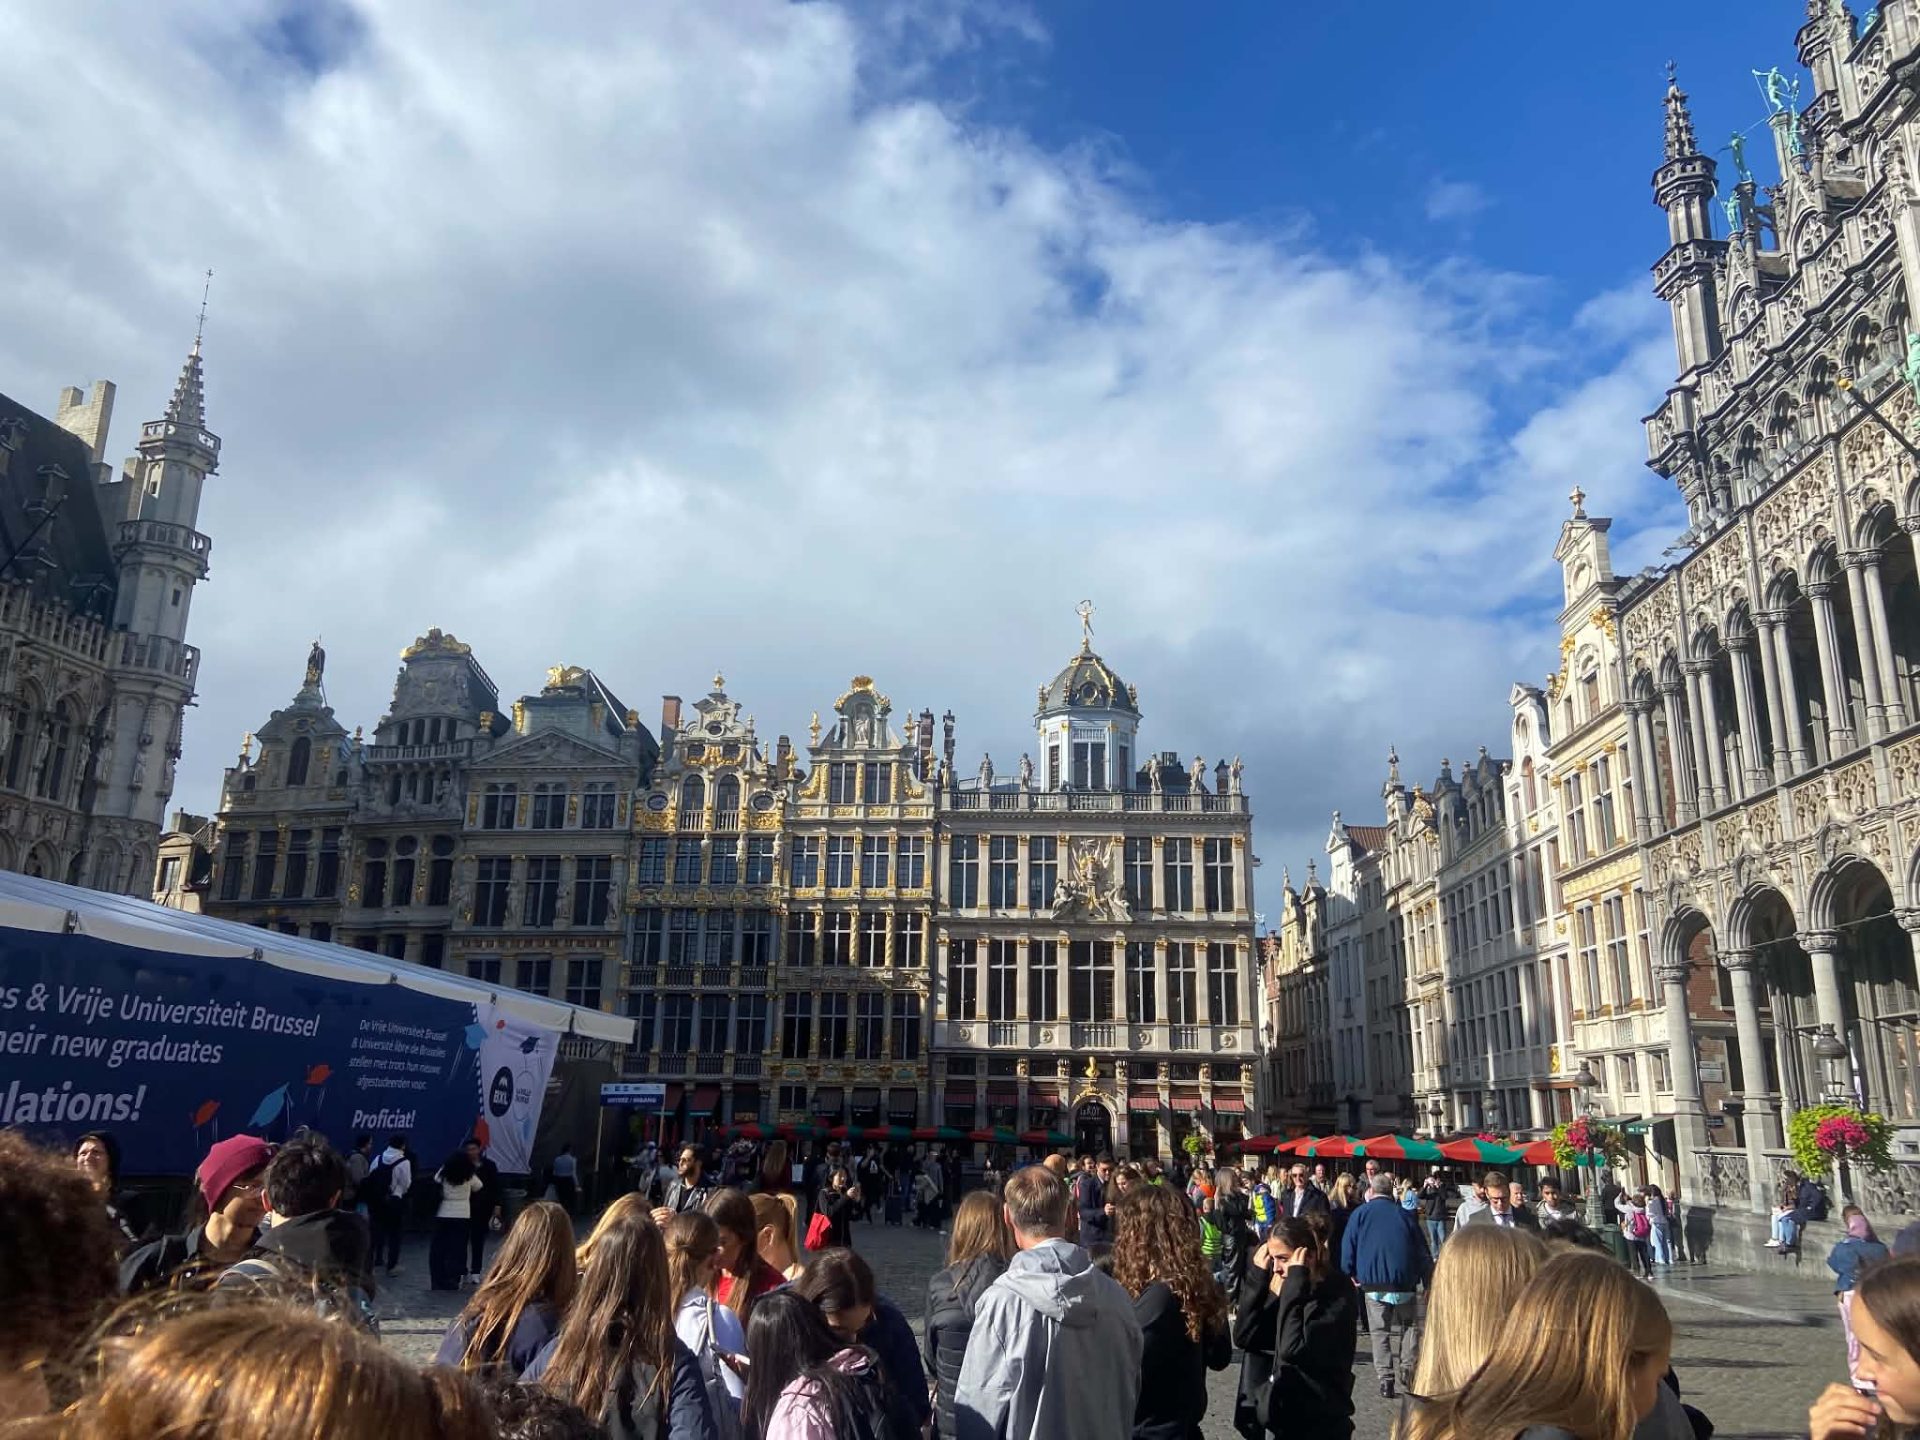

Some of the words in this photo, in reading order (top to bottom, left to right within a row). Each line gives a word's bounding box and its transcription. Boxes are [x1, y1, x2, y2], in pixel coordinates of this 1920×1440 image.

[25, 982, 50, 1012] &
[58, 984, 114, 1026] Vrije
[120, 993, 248, 1029] Universiteit
[251, 1006, 321, 1037] Brussel
[51, 1033, 108, 1058] new
[107, 1034, 223, 1068] graduates
[351, 1107, 417, 1129] Proficiat!
